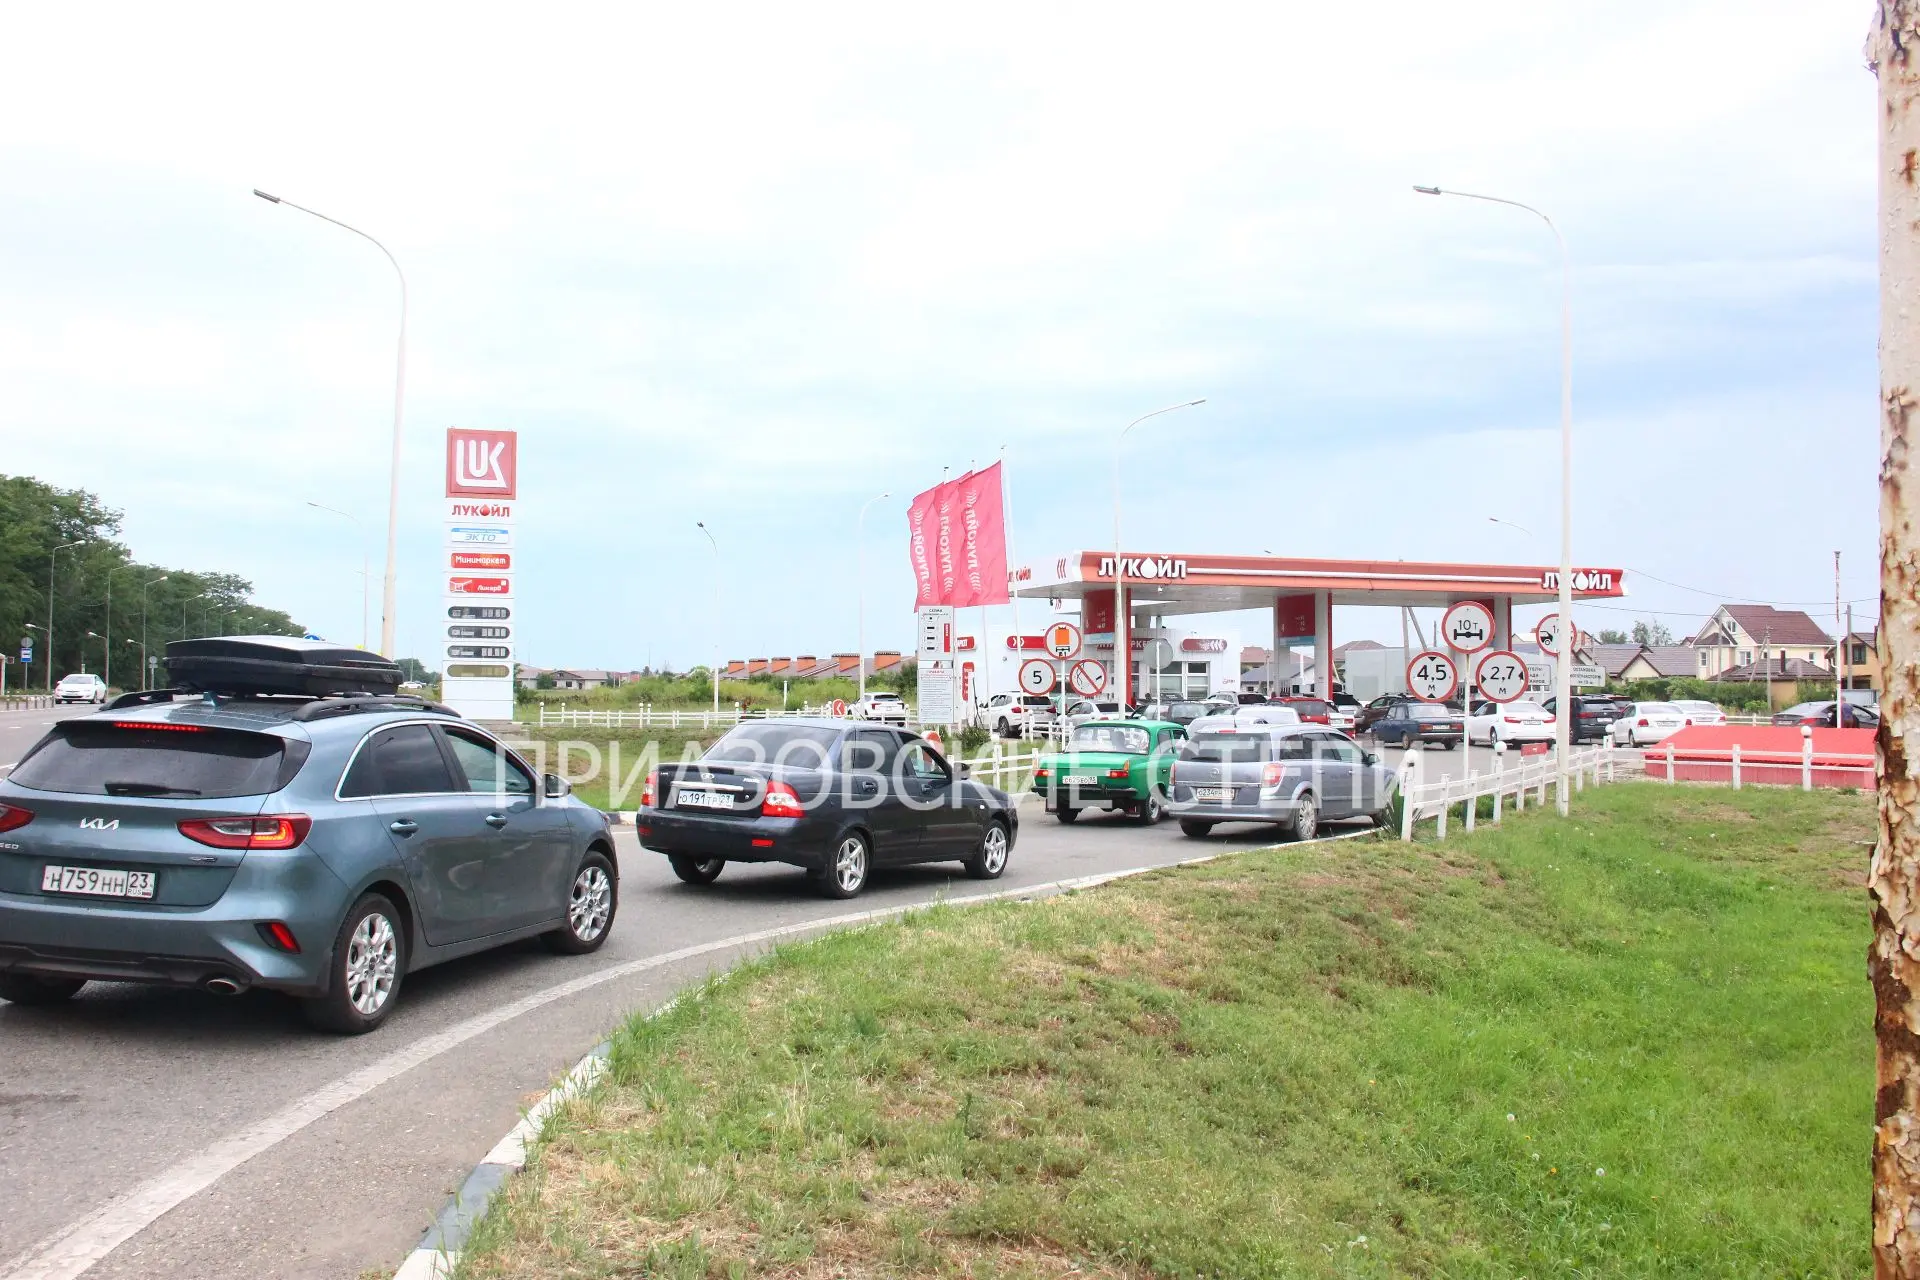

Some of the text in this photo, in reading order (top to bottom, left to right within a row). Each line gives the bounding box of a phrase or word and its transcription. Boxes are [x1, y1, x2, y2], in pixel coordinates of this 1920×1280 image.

[451, 503, 510, 517] ЛУКОЙЛ
[1098, 555, 1186, 579] ЛУКОЙЛ
[1457, 619, 1471, 631] 10
[1033, 670, 1043, 685] 5
[1416, 664, 1447, 682] 4,5
[1489, 666, 1515, 682] 2,7
